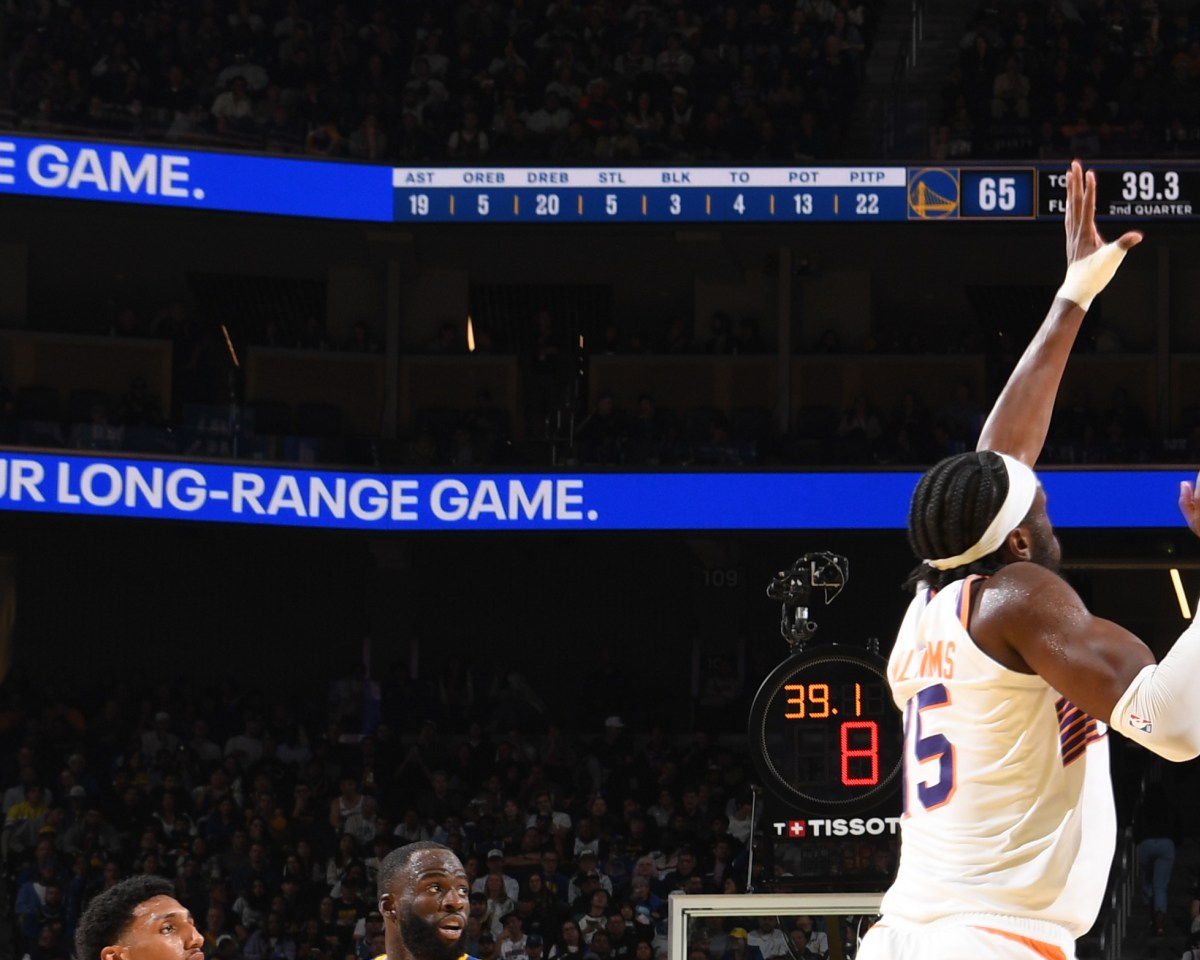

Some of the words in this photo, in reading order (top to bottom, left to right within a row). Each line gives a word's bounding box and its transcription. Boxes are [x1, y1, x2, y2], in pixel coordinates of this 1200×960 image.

[27, 144, 205, 200] GAME.
[405, 172, 434, 184] AST
[463, 172, 505, 184] OREB
[527, 172, 569, 184] DREB
[598, 172, 625, 184] STL
[661, 172, 691, 184] BLK
[729, 172, 750, 184] TO
[788, 172, 819, 184] POT
[850, 172, 886, 184] PITP
[1122, 171, 1179, 201] 39.3
[409, 194, 429, 215] 19
[477, 194, 489, 215] 5
[535, 194, 560, 215] 20
[606, 194, 618, 215] 5
[670, 194, 681, 215] 3
[733, 194, 745, 215] 4
[793, 194, 813, 215] 13
[856, 194, 879, 215] 22
[978, 177, 1016, 211] 65
[1109, 204, 1131, 215] 2nd
[1135, 204, 1192, 215] QUARTER
[57, 462, 419, 521] LONG-RANGE
[430, 479, 599, 522] GAME.
[783, 682, 862, 719] 39.1
[840, 720, 879, 786] 8
[808, 817, 900, 837] TISSOT
